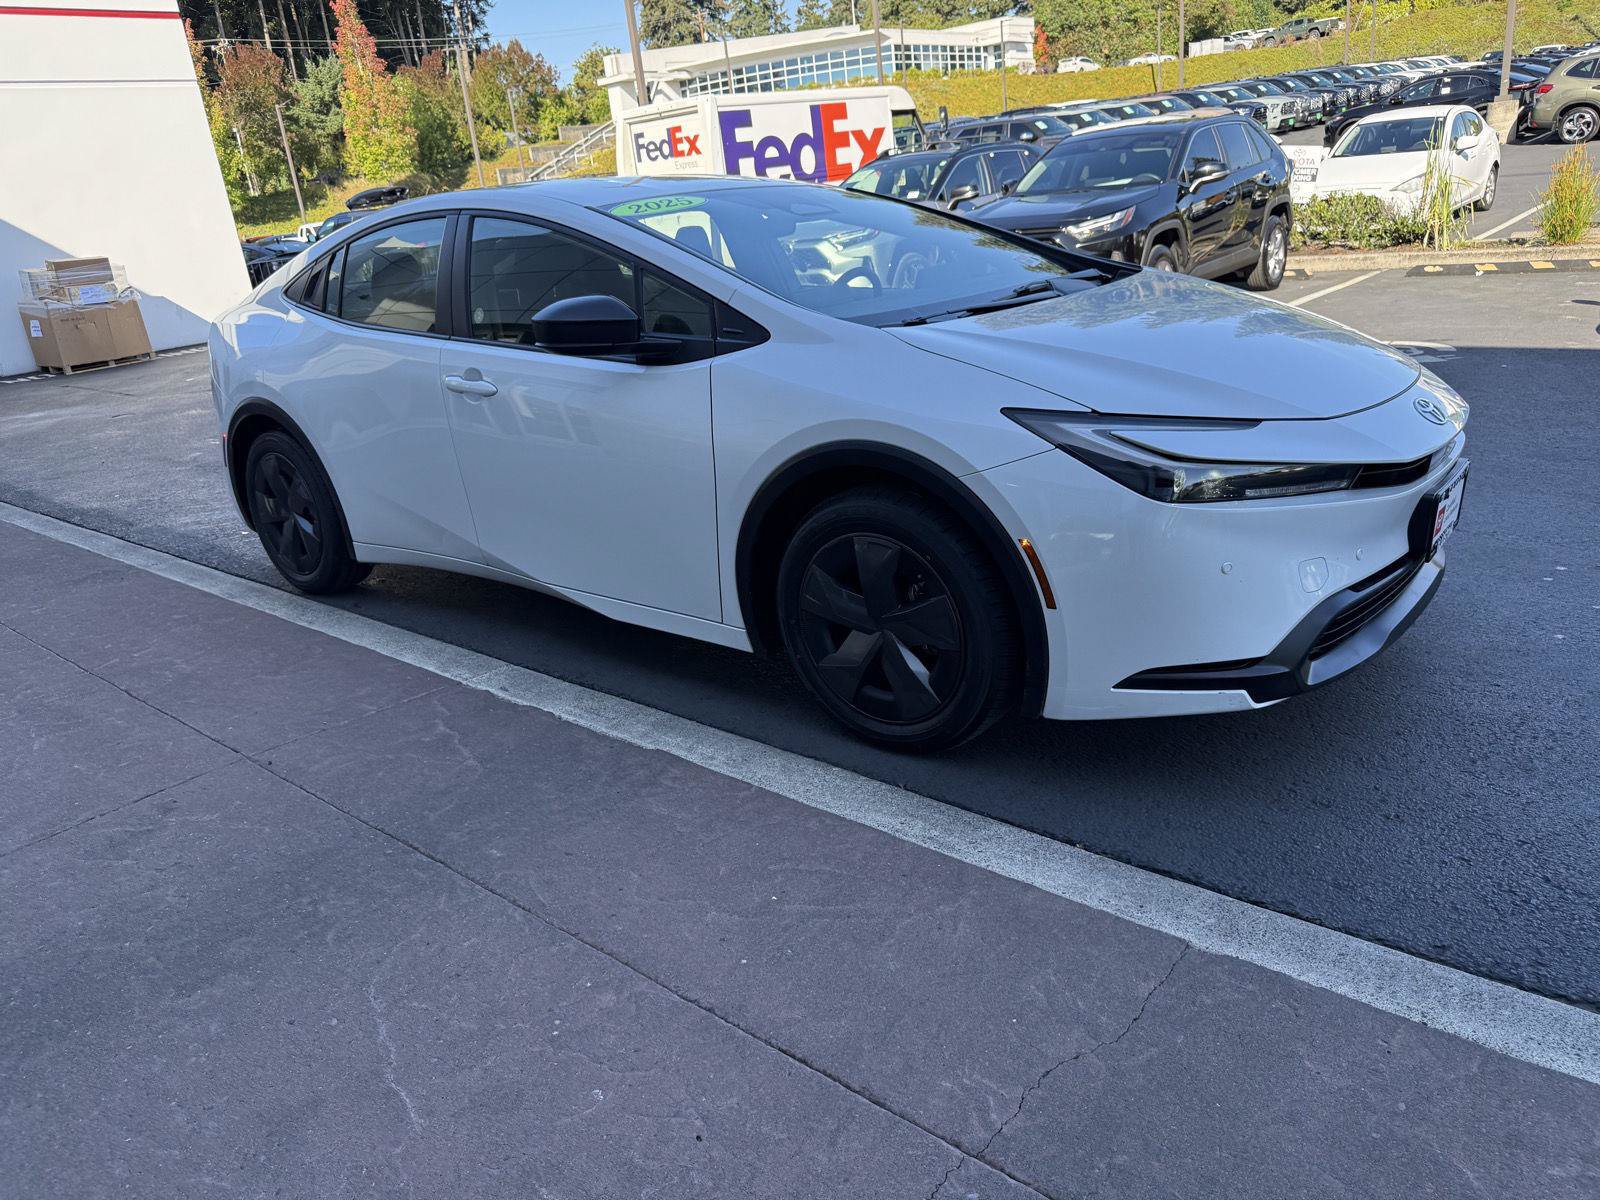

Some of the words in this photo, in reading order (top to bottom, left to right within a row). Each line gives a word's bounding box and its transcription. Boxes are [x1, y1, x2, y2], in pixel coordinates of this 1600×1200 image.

[634, 125, 702, 163] FedEx
[718, 102, 887, 182] FedEx
[674, 160, 698, 169] Express
[1296, 158, 1316, 166] OTA
[1294, 167, 1317, 175] OMER
[628, 197, 693, 213] 2025
